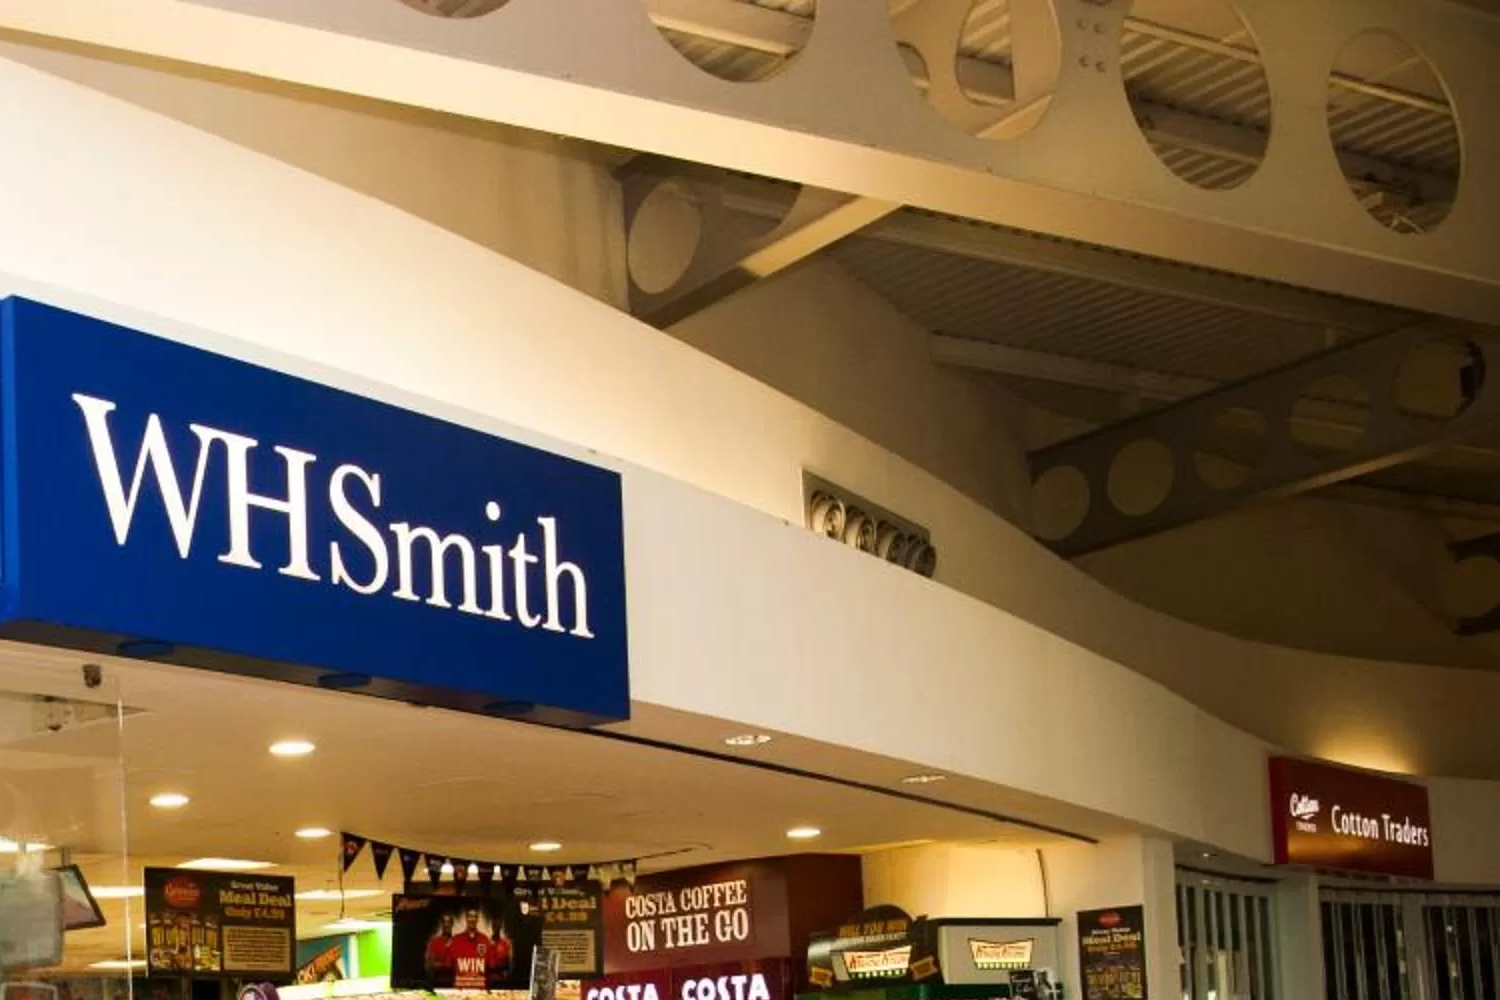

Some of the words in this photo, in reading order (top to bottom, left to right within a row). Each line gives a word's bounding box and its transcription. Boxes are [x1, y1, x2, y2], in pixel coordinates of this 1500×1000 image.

[71, 393, 595, 640] WHSmith
[1331, 805, 1379, 839] Cotton
[1381, 814, 1429, 847] Traders
[625, 892, 677, 919] COSTA
[680, 880, 747, 912] COFFEE
[626, 919, 655, 952] ON
[661, 912, 709, 948] THE
[715, 908, 749, 941] GO
[457, 958, 485, 972] WIN
